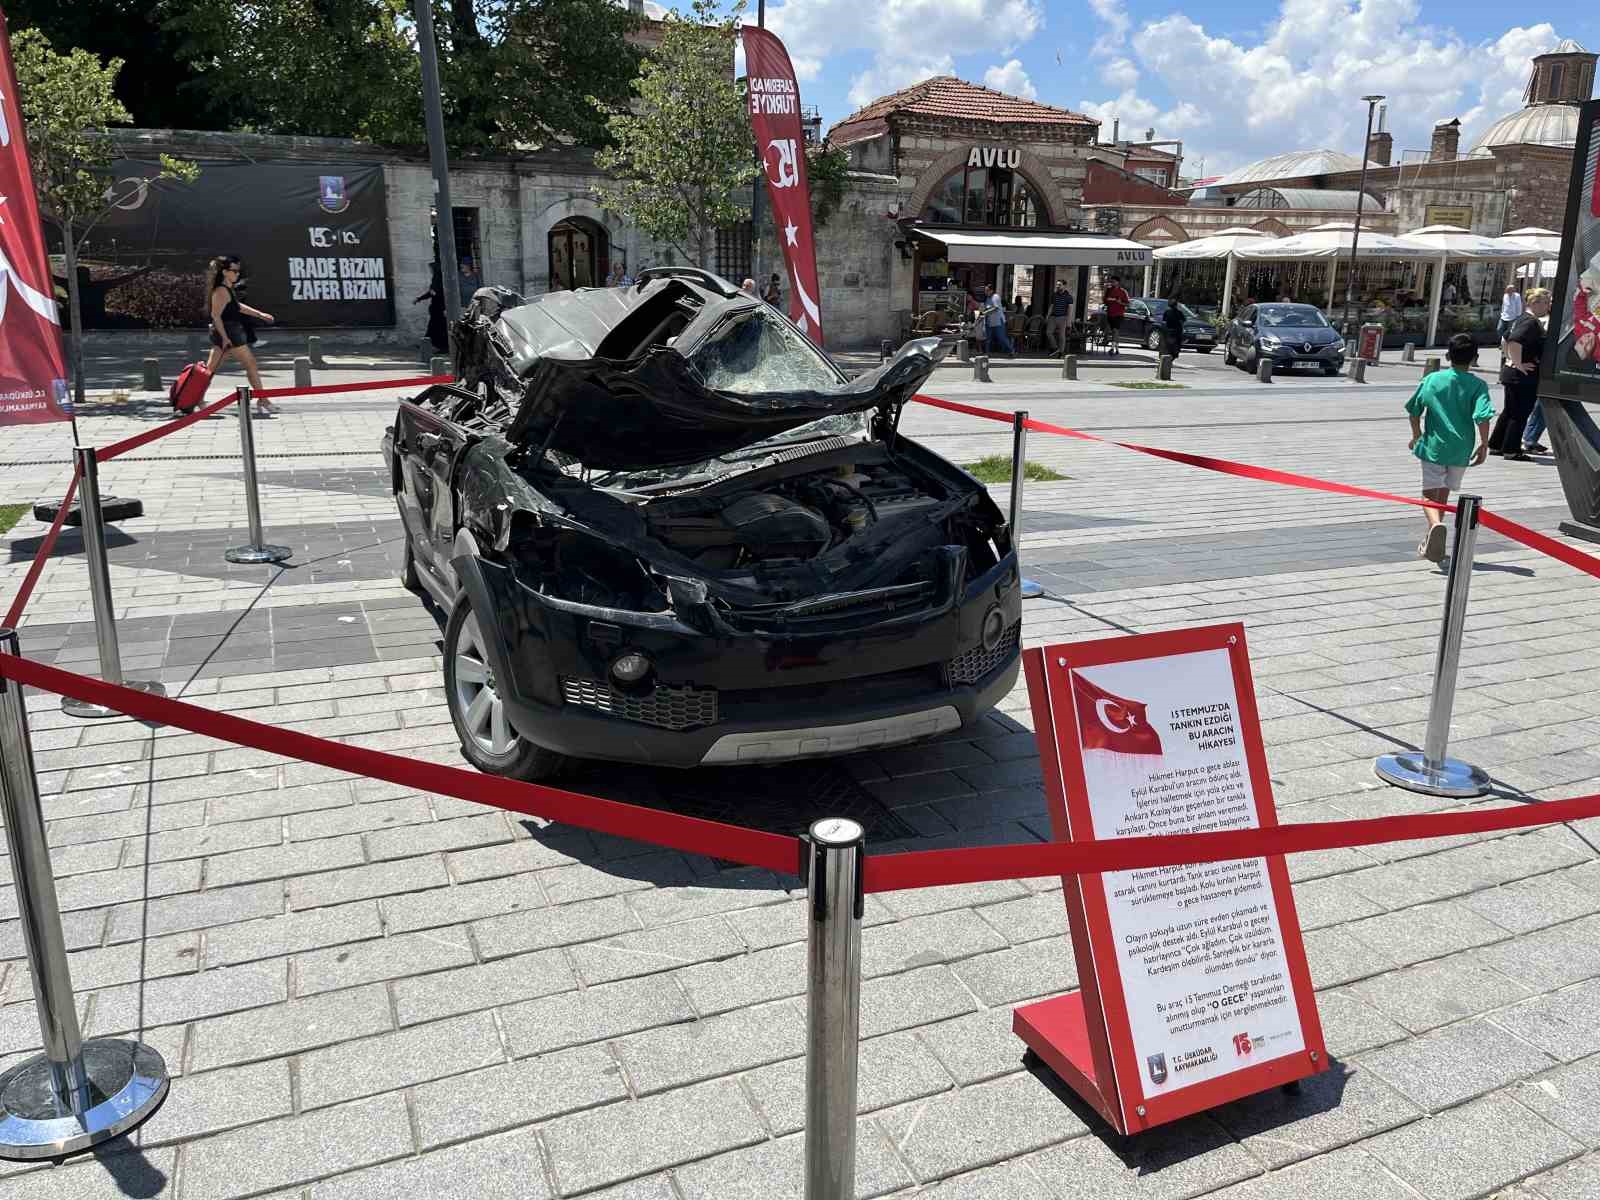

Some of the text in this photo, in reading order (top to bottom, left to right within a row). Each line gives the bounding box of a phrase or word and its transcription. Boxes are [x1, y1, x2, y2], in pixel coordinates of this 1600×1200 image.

[968, 147, 1021, 169] AVLU
[1117, 251, 1145, 260] AVLU
[288, 257, 385, 279] İRADE BİZİM
[291, 280, 387, 301] ZAFER BİZİM
[1180, 703, 1230, 716] TEMMUZ'DA
[1169, 712, 1232, 730] TANKIN EZDİĞİ
[1202, 726, 1234, 737] ARACIN
[1198, 737, 1236, 750] HİKAYESİ
